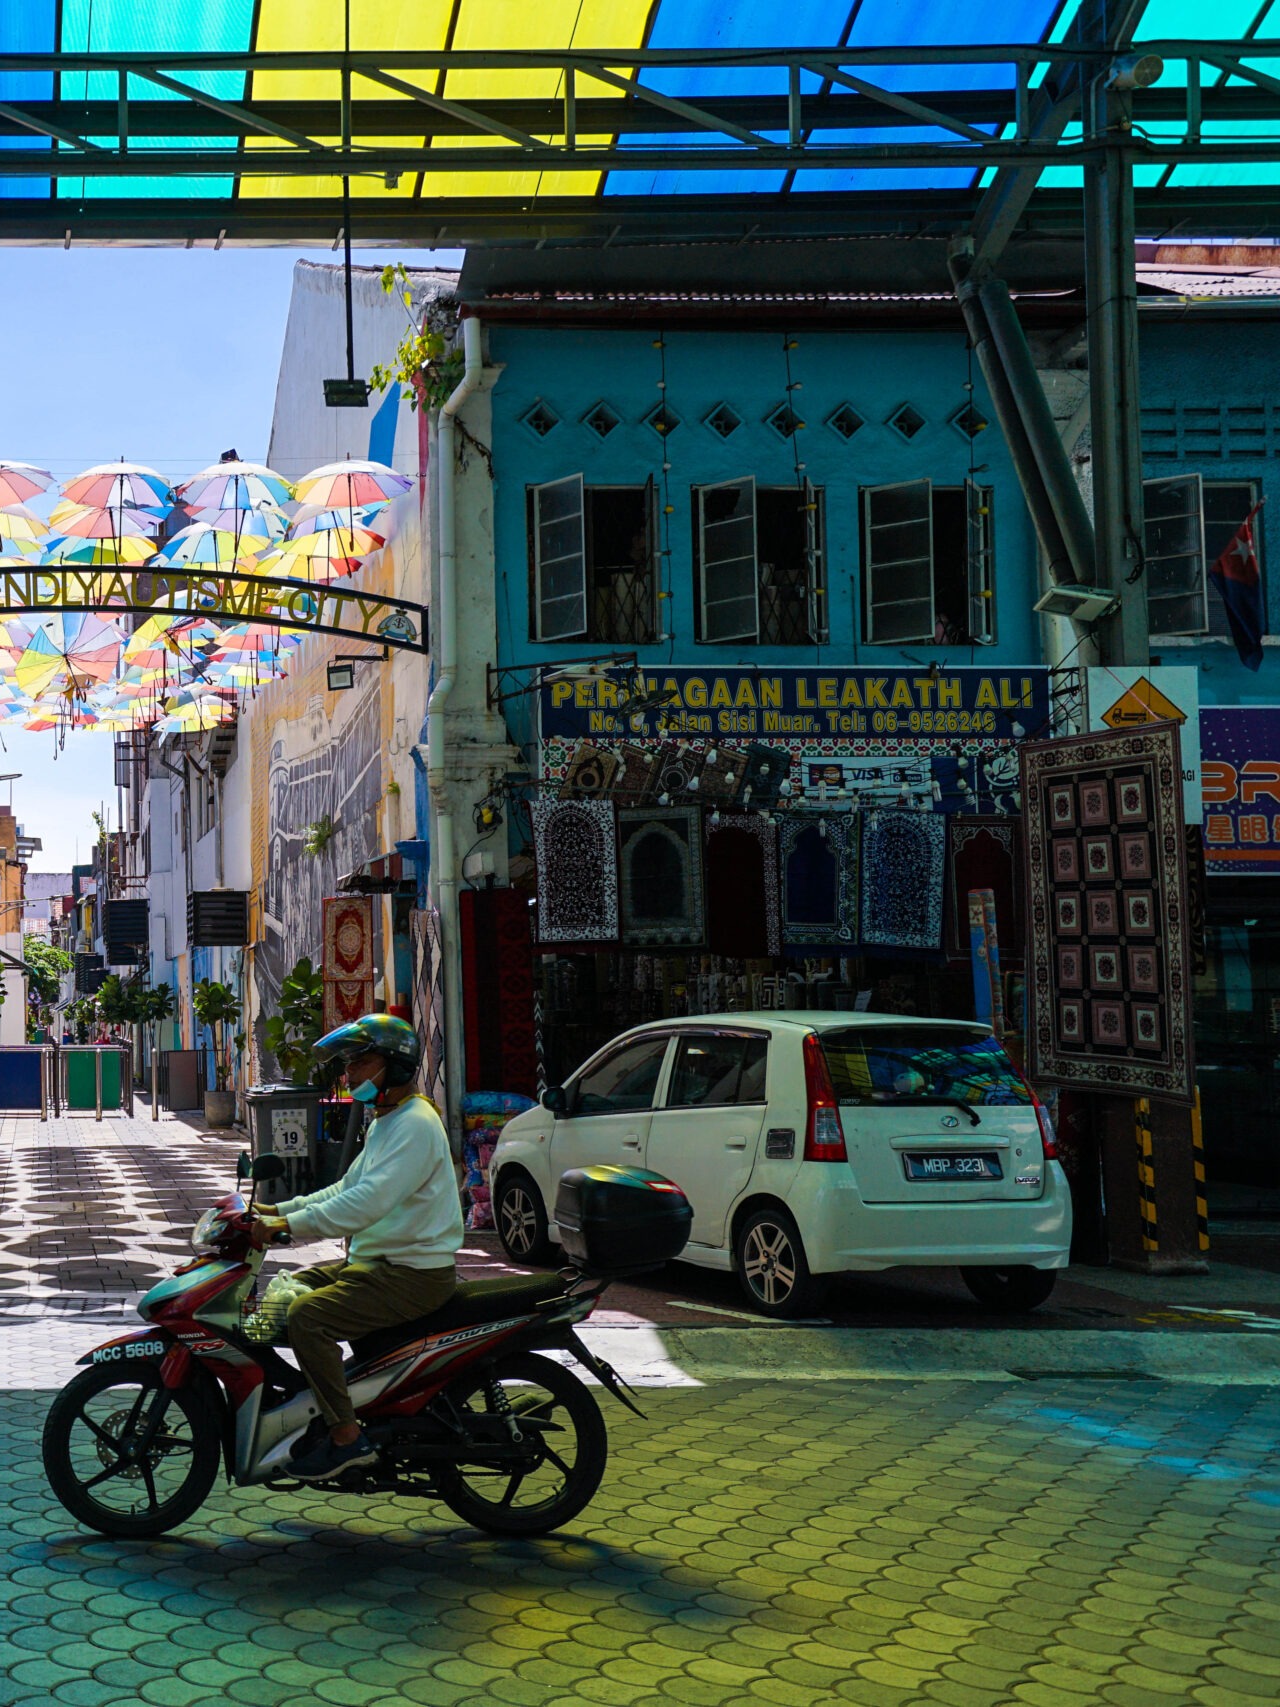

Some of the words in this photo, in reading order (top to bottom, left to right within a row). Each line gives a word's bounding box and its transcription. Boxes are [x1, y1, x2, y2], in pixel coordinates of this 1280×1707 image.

[103, 573, 281, 616] AUTISME
[287, 588, 386, 633] CITY
[796, 677, 962, 708] LEAKATH
[975, 677, 1034, 708] ALI
[590, 710, 624, 732] No.
[656, 710, 712, 733] Jalan
[718, 710, 758, 733] Sisi
[763, 710, 820, 733] Muar.
[826, 710, 867, 733] Tel:
[872, 710, 996, 733] 06-9526246
[1206, 814, 1280, 844] 星眼
[282, 1131, 298, 1144] 19
[923, 1158, 950, 1173] MBP
[955, 1158, 985, 1173] 3231
[93, 1346, 122, 1364] MCC
[125, 1340, 165, 1359] 5608
